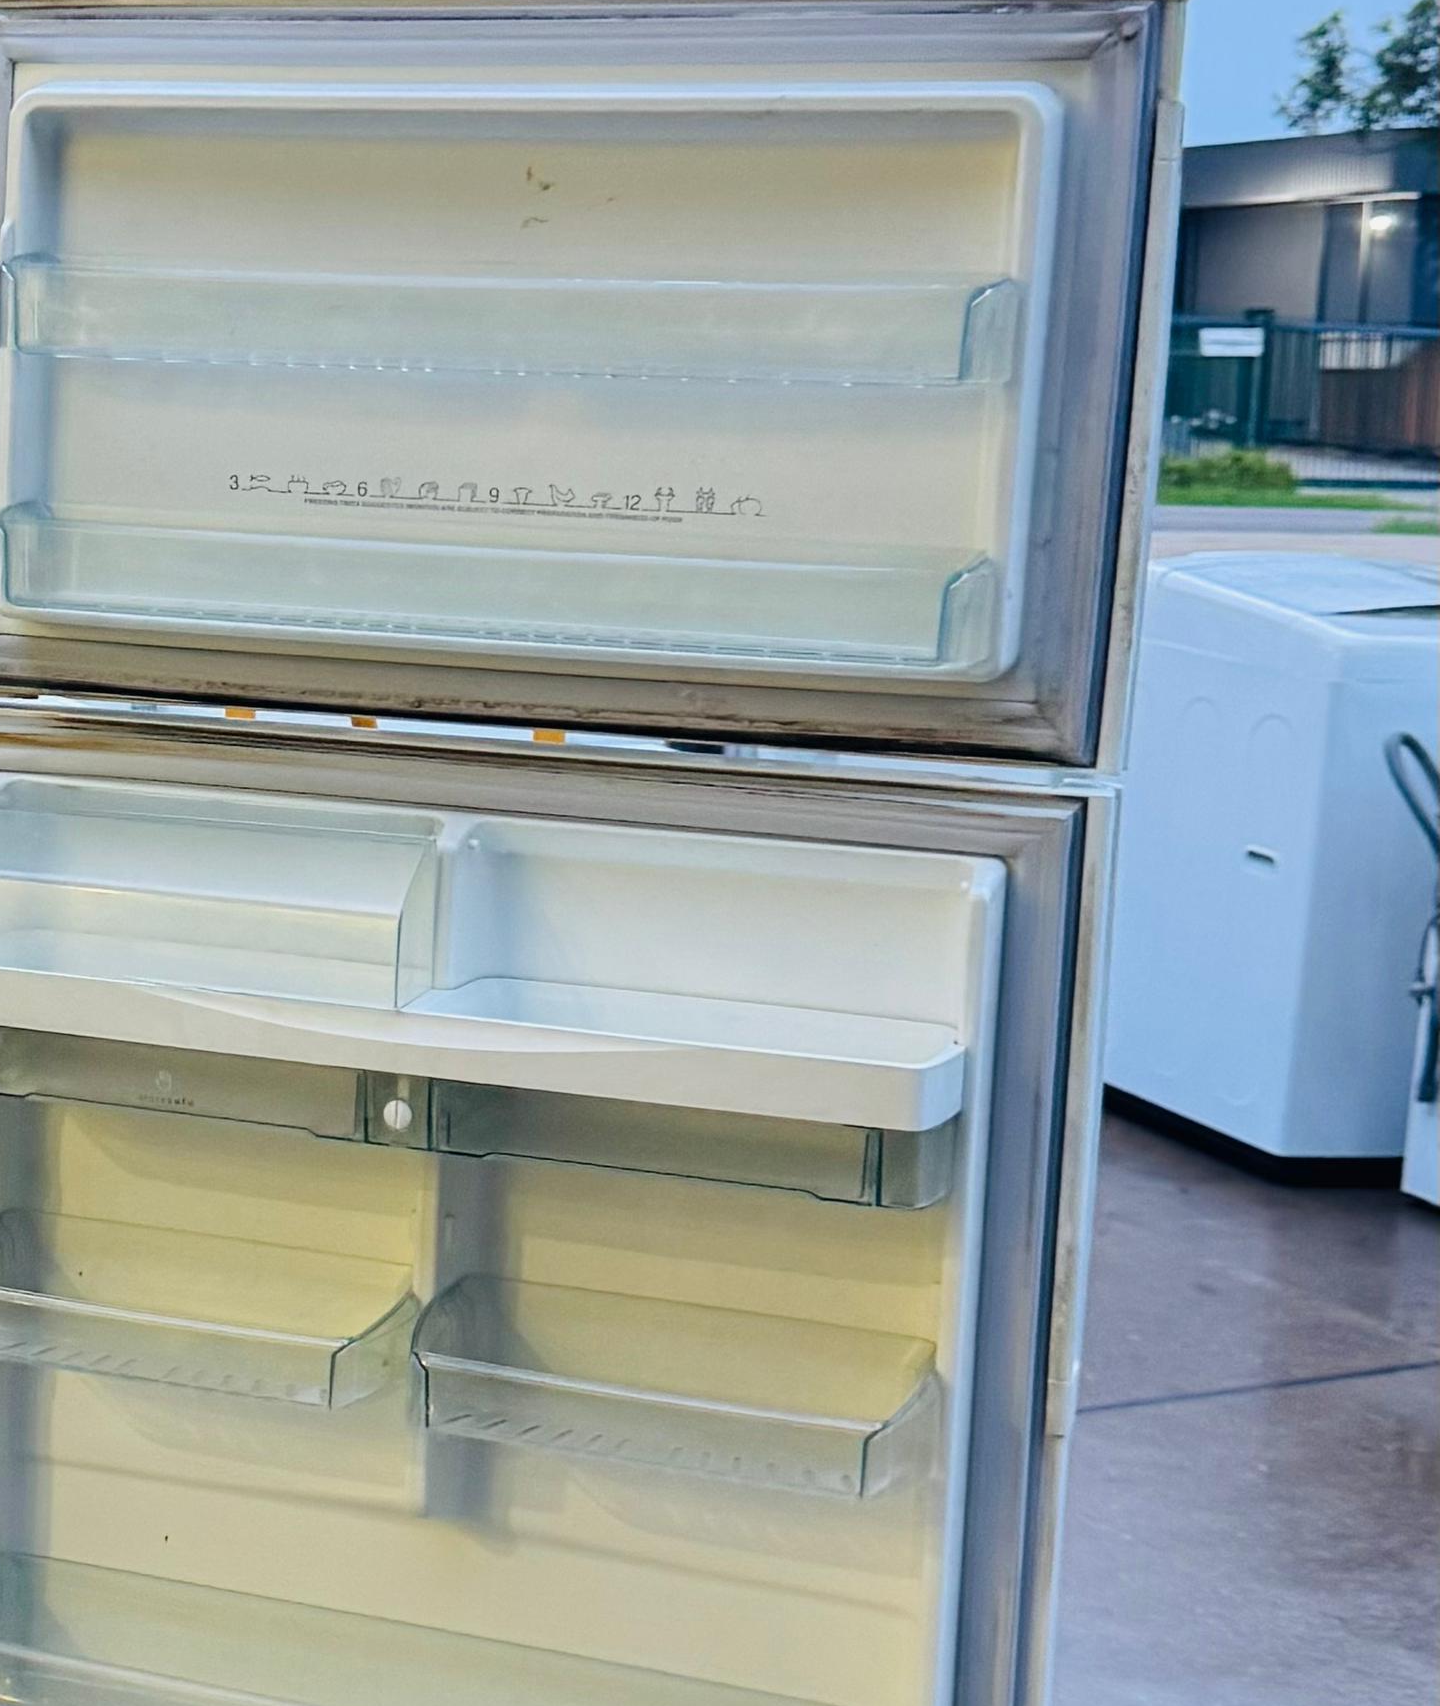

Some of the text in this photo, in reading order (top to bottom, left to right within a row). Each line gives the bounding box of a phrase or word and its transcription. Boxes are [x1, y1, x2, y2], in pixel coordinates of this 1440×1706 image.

[229, 474, 239, 490] 3
[357, 481, 368, 497] 6
[488, 487, 499, 503] 9
[625, 494, 642, 511] 12
